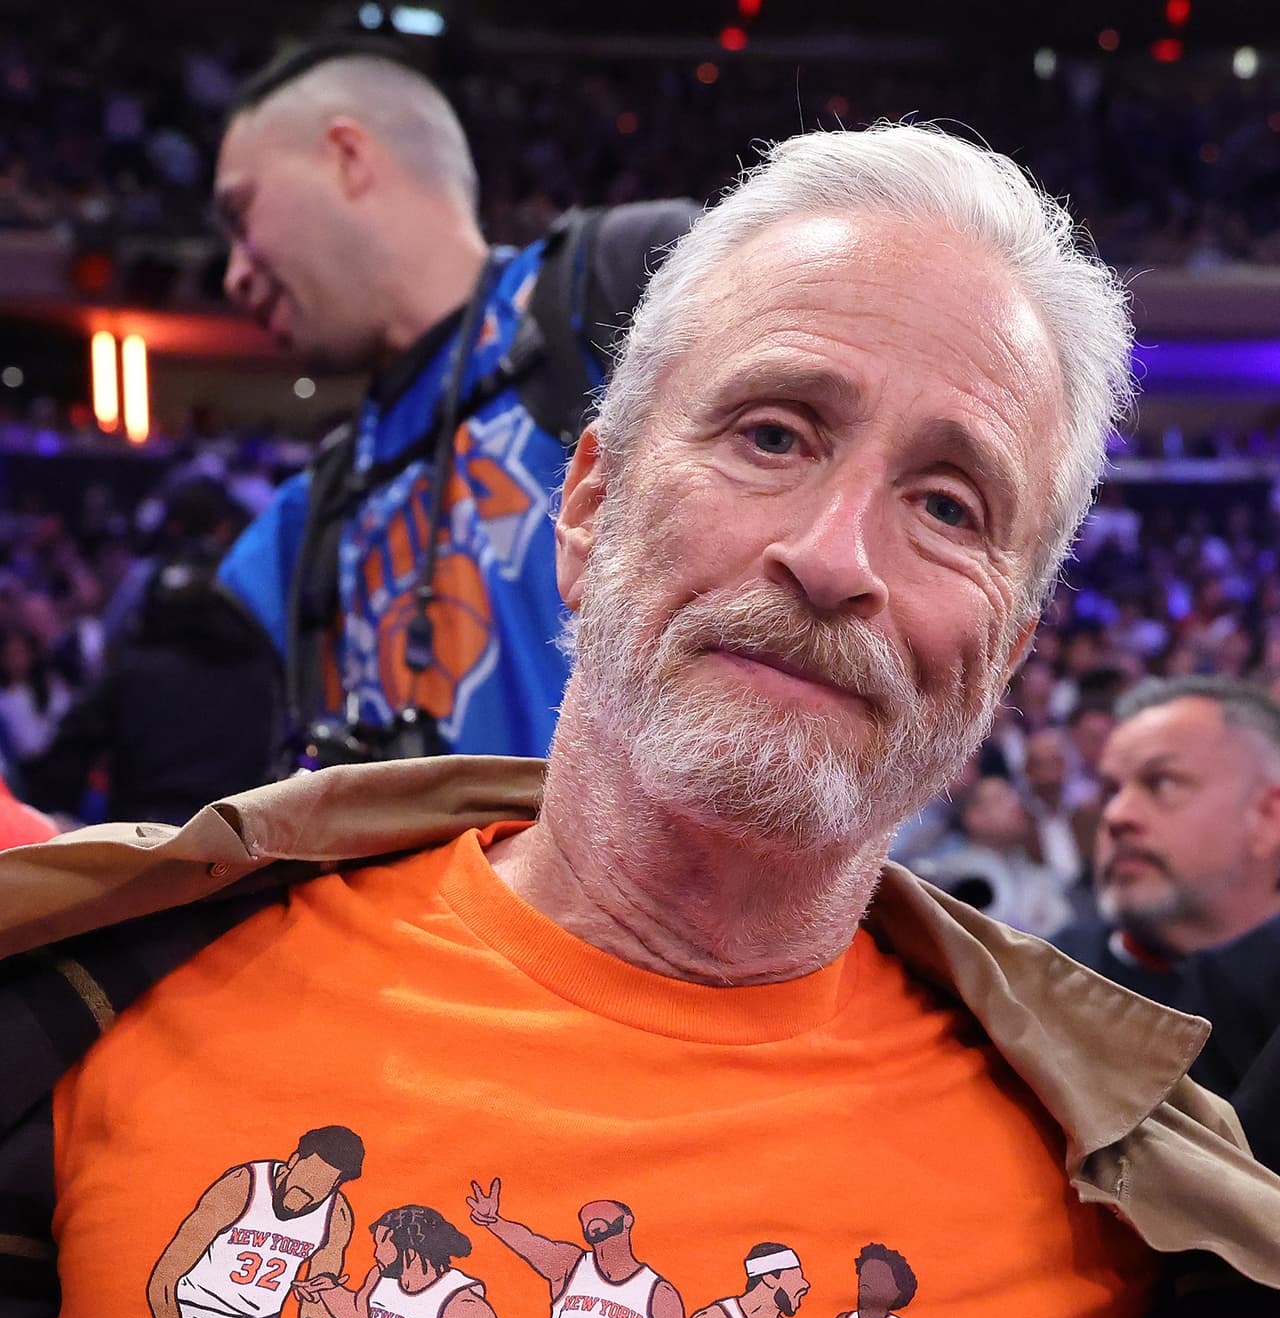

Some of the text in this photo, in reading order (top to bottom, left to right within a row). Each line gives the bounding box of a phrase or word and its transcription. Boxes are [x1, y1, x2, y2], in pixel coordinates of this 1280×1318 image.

[228, 1227, 316, 1258] NEW YORK
[230, 1251, 288, 1292] 32
[564, 1295, 600, 1312] NEW
